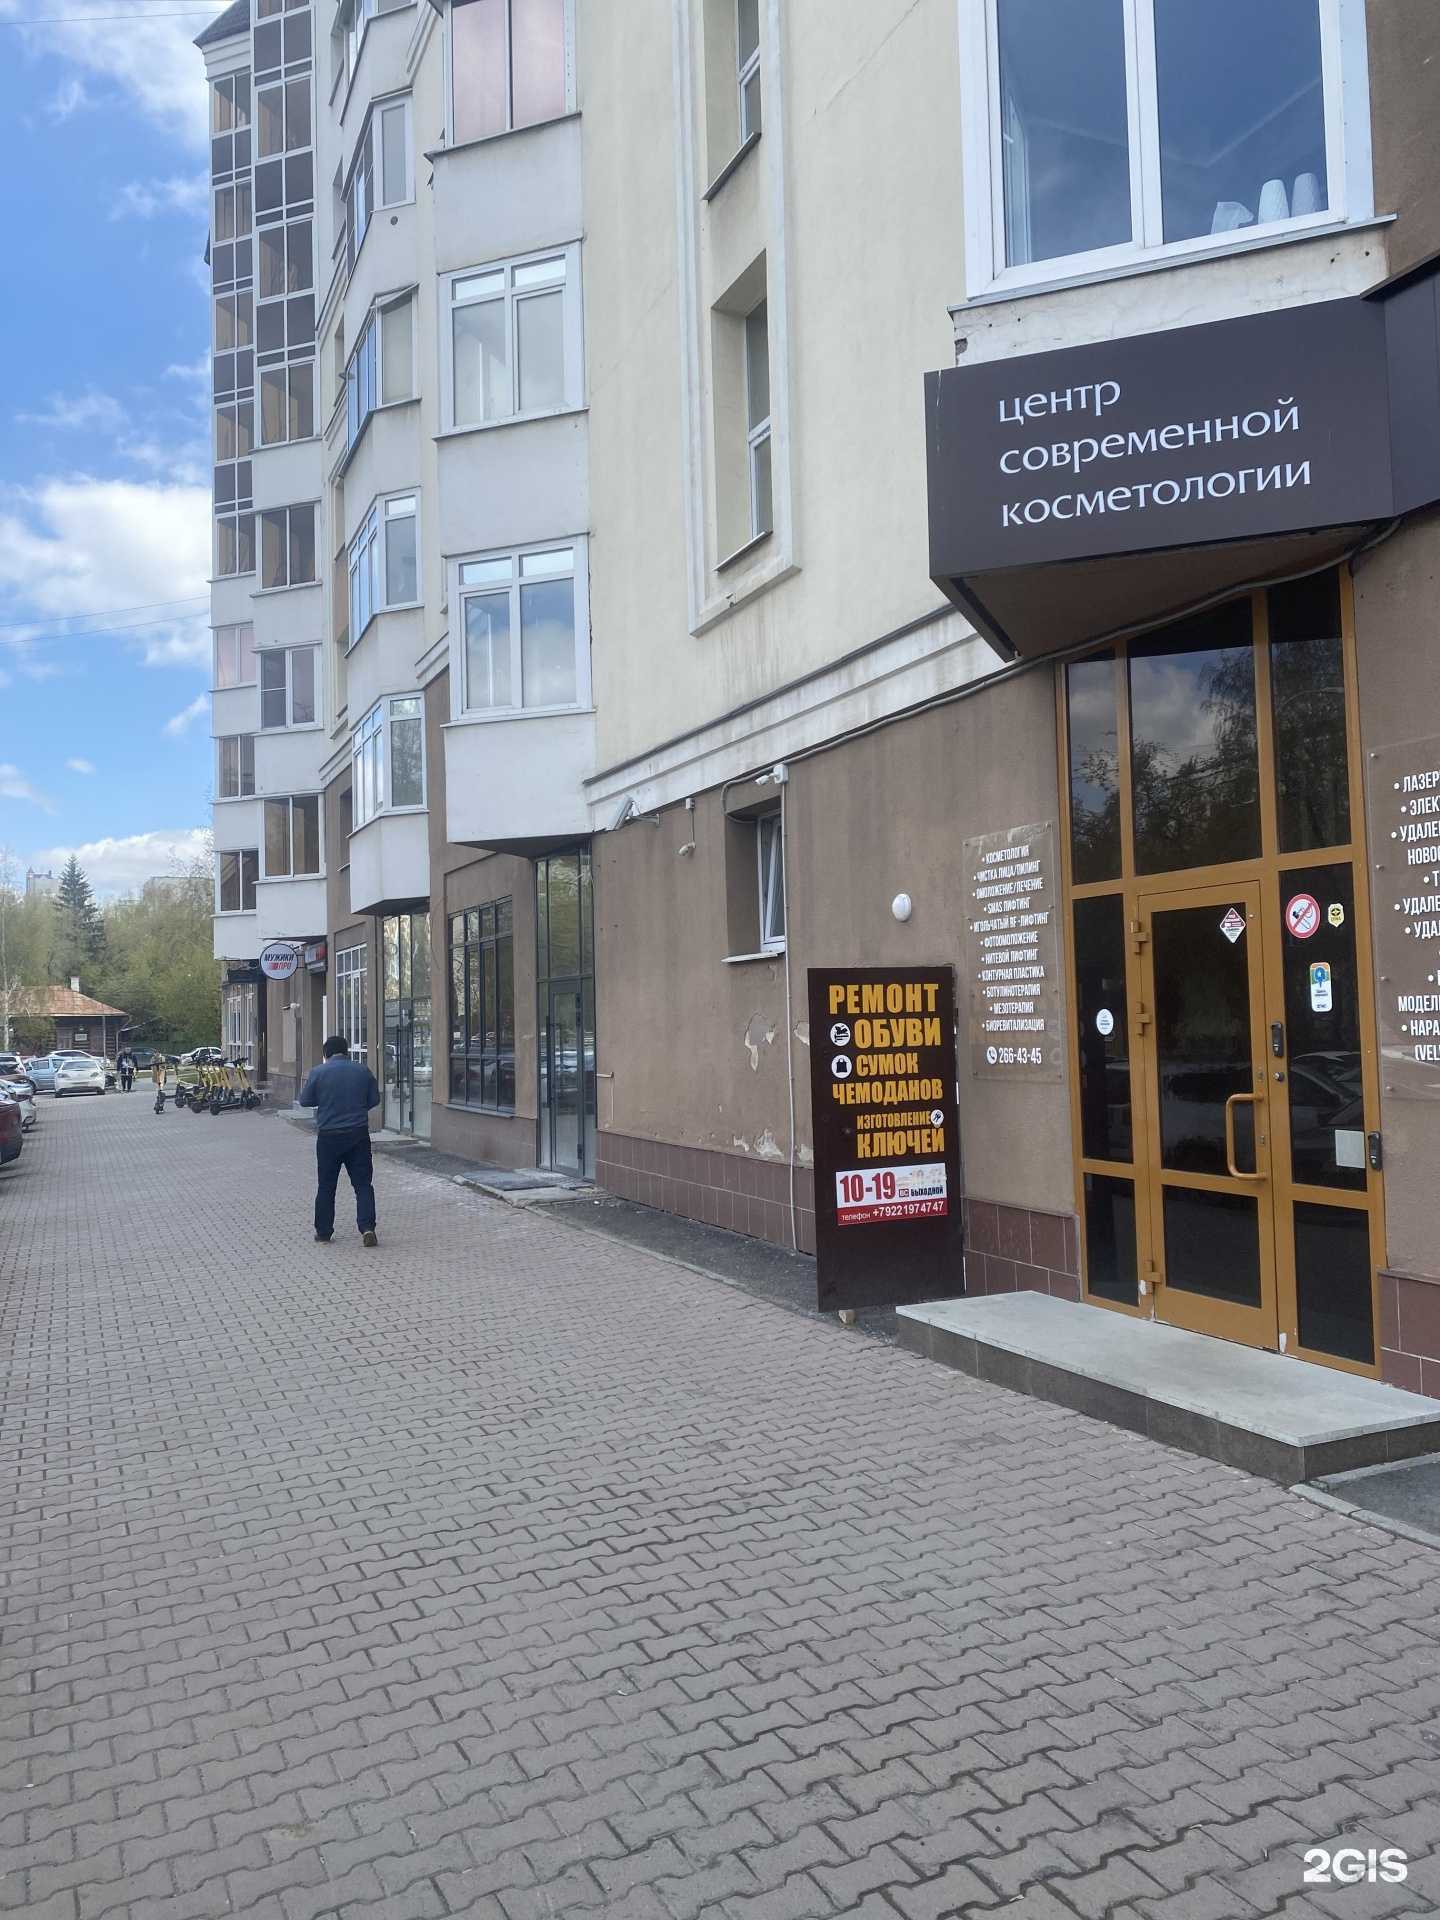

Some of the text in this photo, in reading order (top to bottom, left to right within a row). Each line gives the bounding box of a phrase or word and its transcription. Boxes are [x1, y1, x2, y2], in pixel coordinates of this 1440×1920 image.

[999, 380, 1121, 426] центр
[1000, 397, 1300, 474] современной
[1002, 460, 1311, 528] косметологии
[1403, 770, 1440, 793] ЛАЗЕР
[1410, 795, 1440, 816] ЭЛЕК
[1400, 820, 1440, 843] УДАЛЕ
[986, 845, 1030, 864] КОСМЕТОЛОГИЯ
[977, 868, 998, 882] ЧИСТКА
[1003, 897, 1031, 912] ЛИФТИНГ
[973, 915, 1009, 933] ИГОЛЬЧАТЫЙ
[1413, 920, 1440, 940] УДА
[984, 931, 1039, 948] ФОТООМОЛОЖЕНИЕ
[264, 953, 294, 961] МУЖИКИ
[985, 948, 1039, 965] НИТЕВОЙ ЛИФТИНГ
[982, 965, 1045, 982] КОНТУРНАЯ ПЛАСТИКА
[829, 983, 939, 1015] РЕМОНТ
[986, 983, 1041, 998] БОТУЛИНОТЕРАПИЯ
[993, 1001, 1034, 1015] МЕЗОТЕРАПИЯ
[1398, 994, 1440, 1014] МОДЕЛ
[854, 1017, 942, 1049] ОБУВИ
[986, 1018, 1045, 1032] БИОРЕВИТАЛИЗАЦИЯ
[998, 1047, 1042, 1064] 266-43-45
[1414, 1043, 1440, 1061] (VEL
[856, 1052, 919, 1077] СУМОК
[832, 1078, 943, 1106] ЧЕМОДАНОВ
[856, 1110, 932, 1130] ИЗГОТОВЛЕНИЕ
[840, 1171, 896, 1203] 10-19
[842, 1200, 944, 1221] телефон +79221974747
